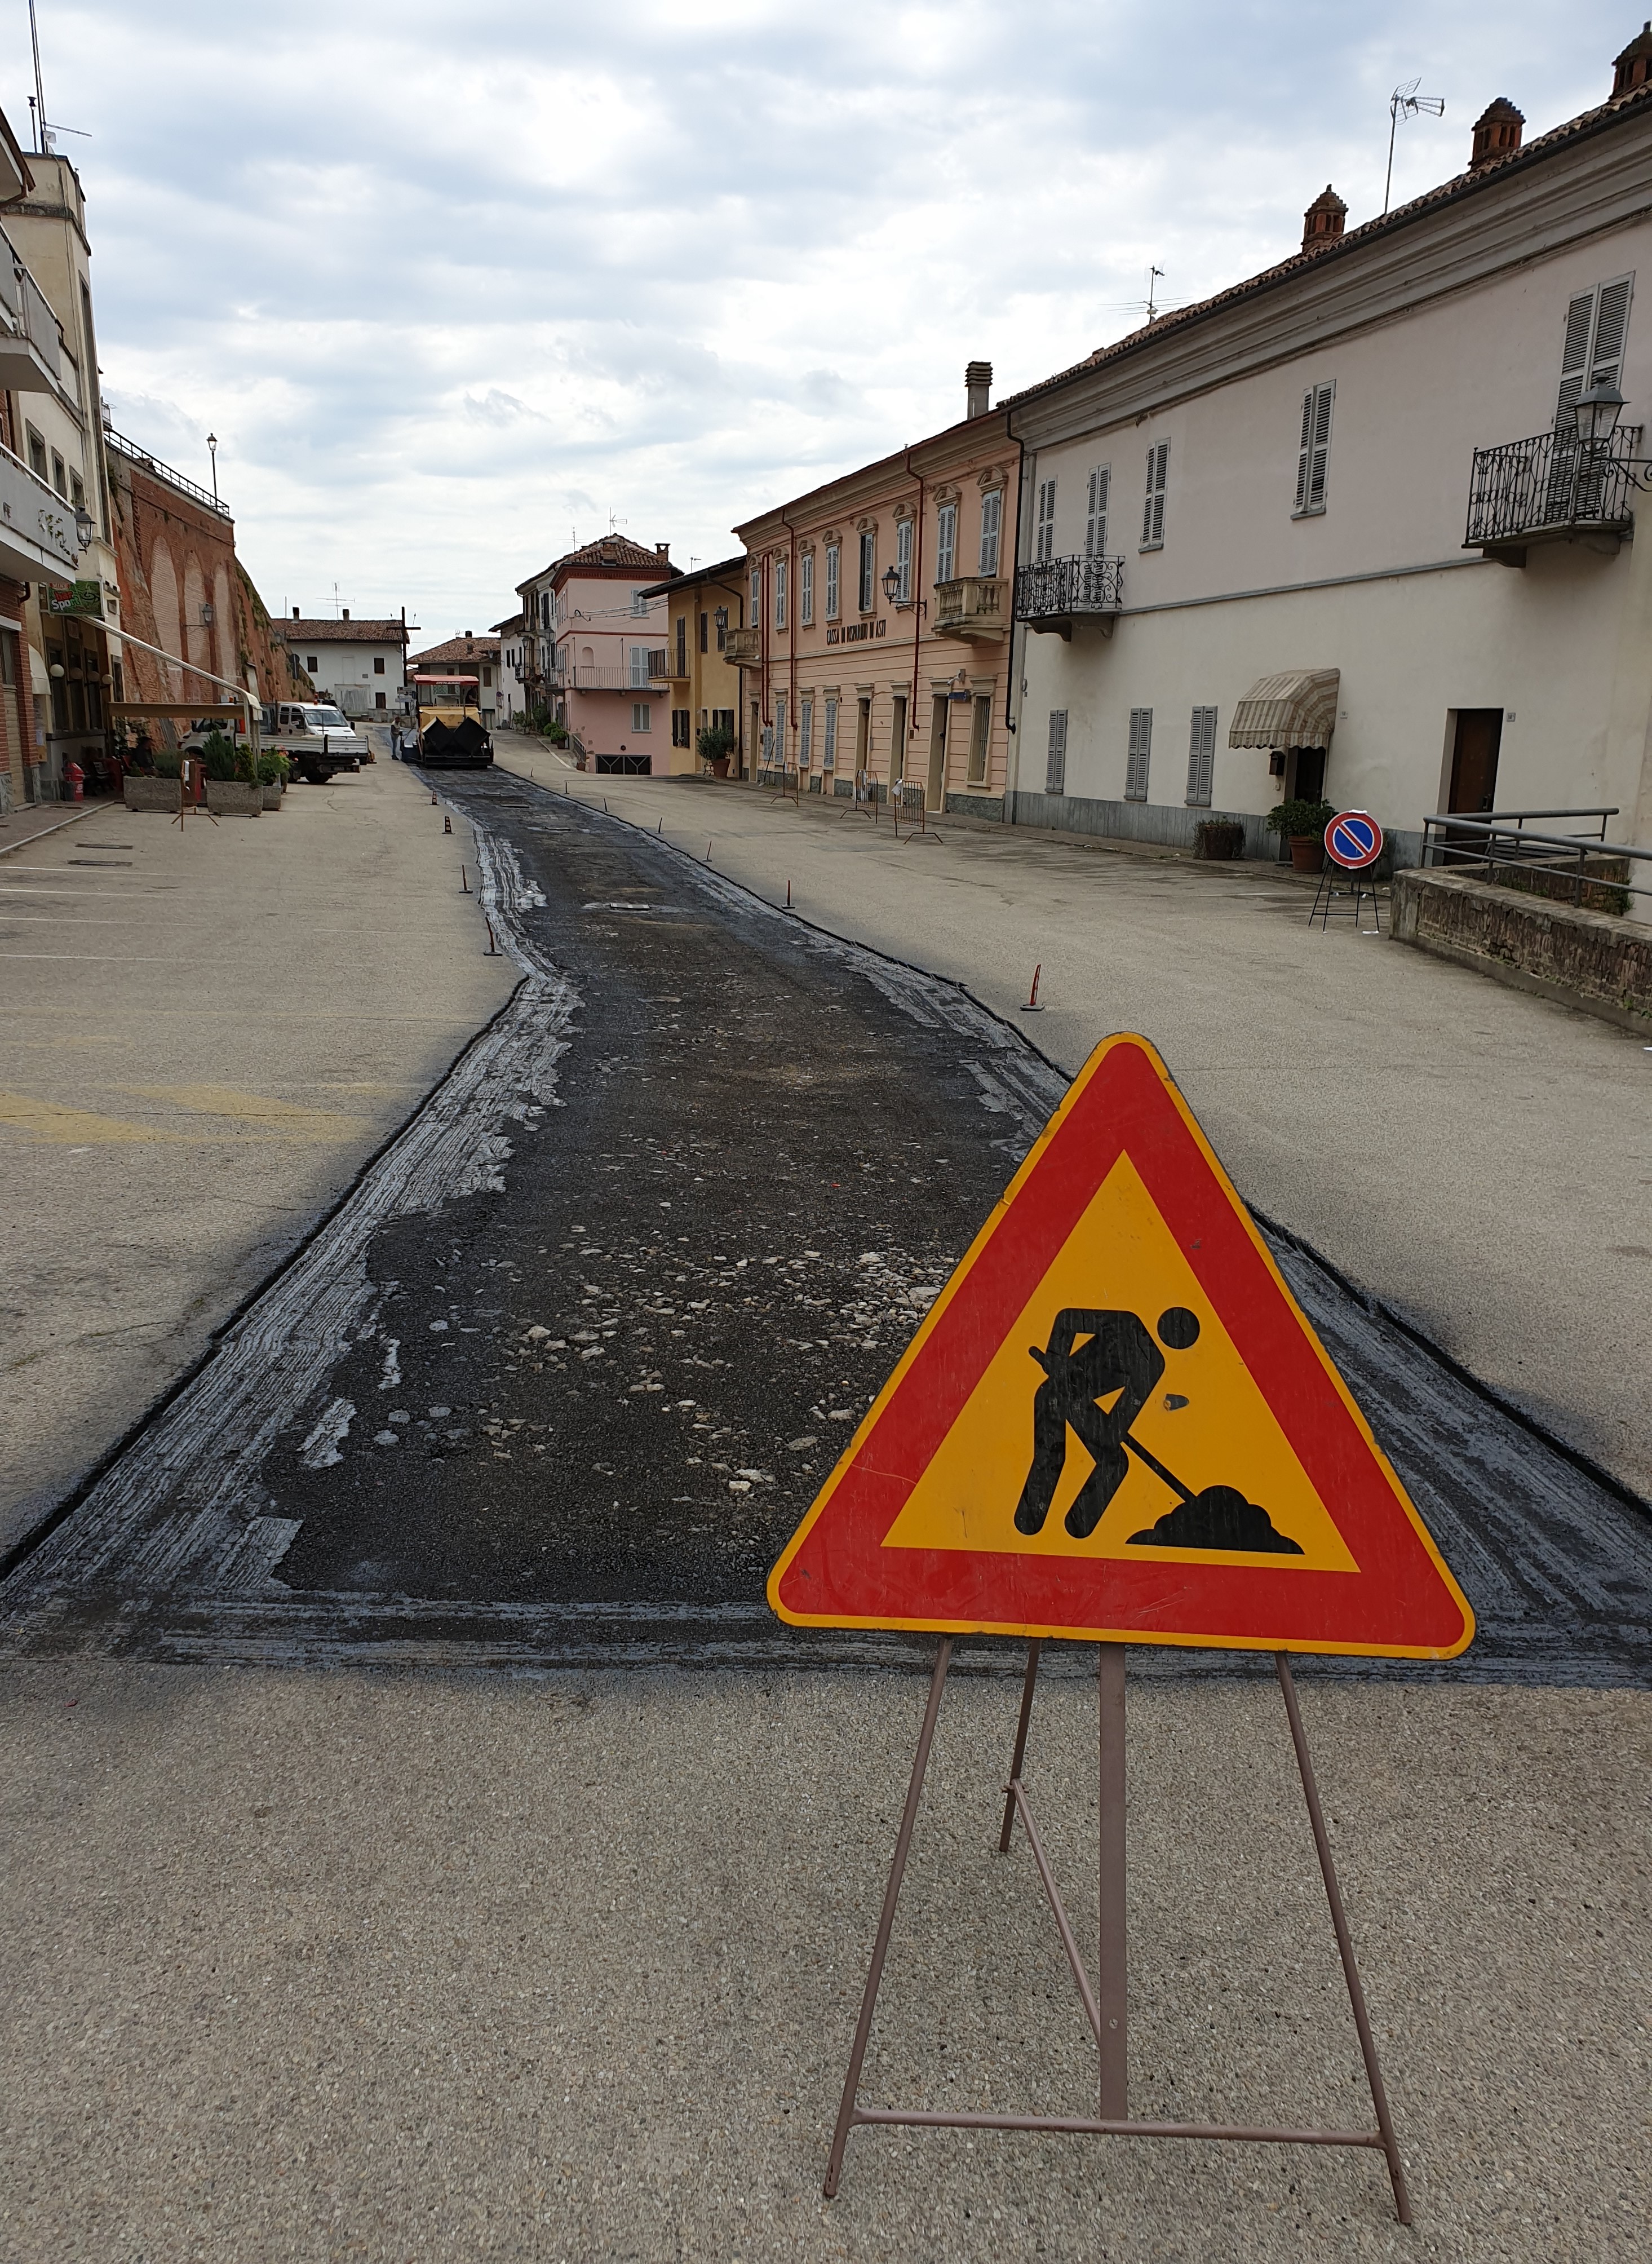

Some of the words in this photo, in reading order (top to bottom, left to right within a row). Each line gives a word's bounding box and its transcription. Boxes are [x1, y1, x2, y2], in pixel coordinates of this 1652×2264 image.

[51, 596, 81, 611] Sport
[54, 591, 73, 602] bar
[827, 628, 840, 645] CASSA
[875, 619, 886, 638] ASTI
